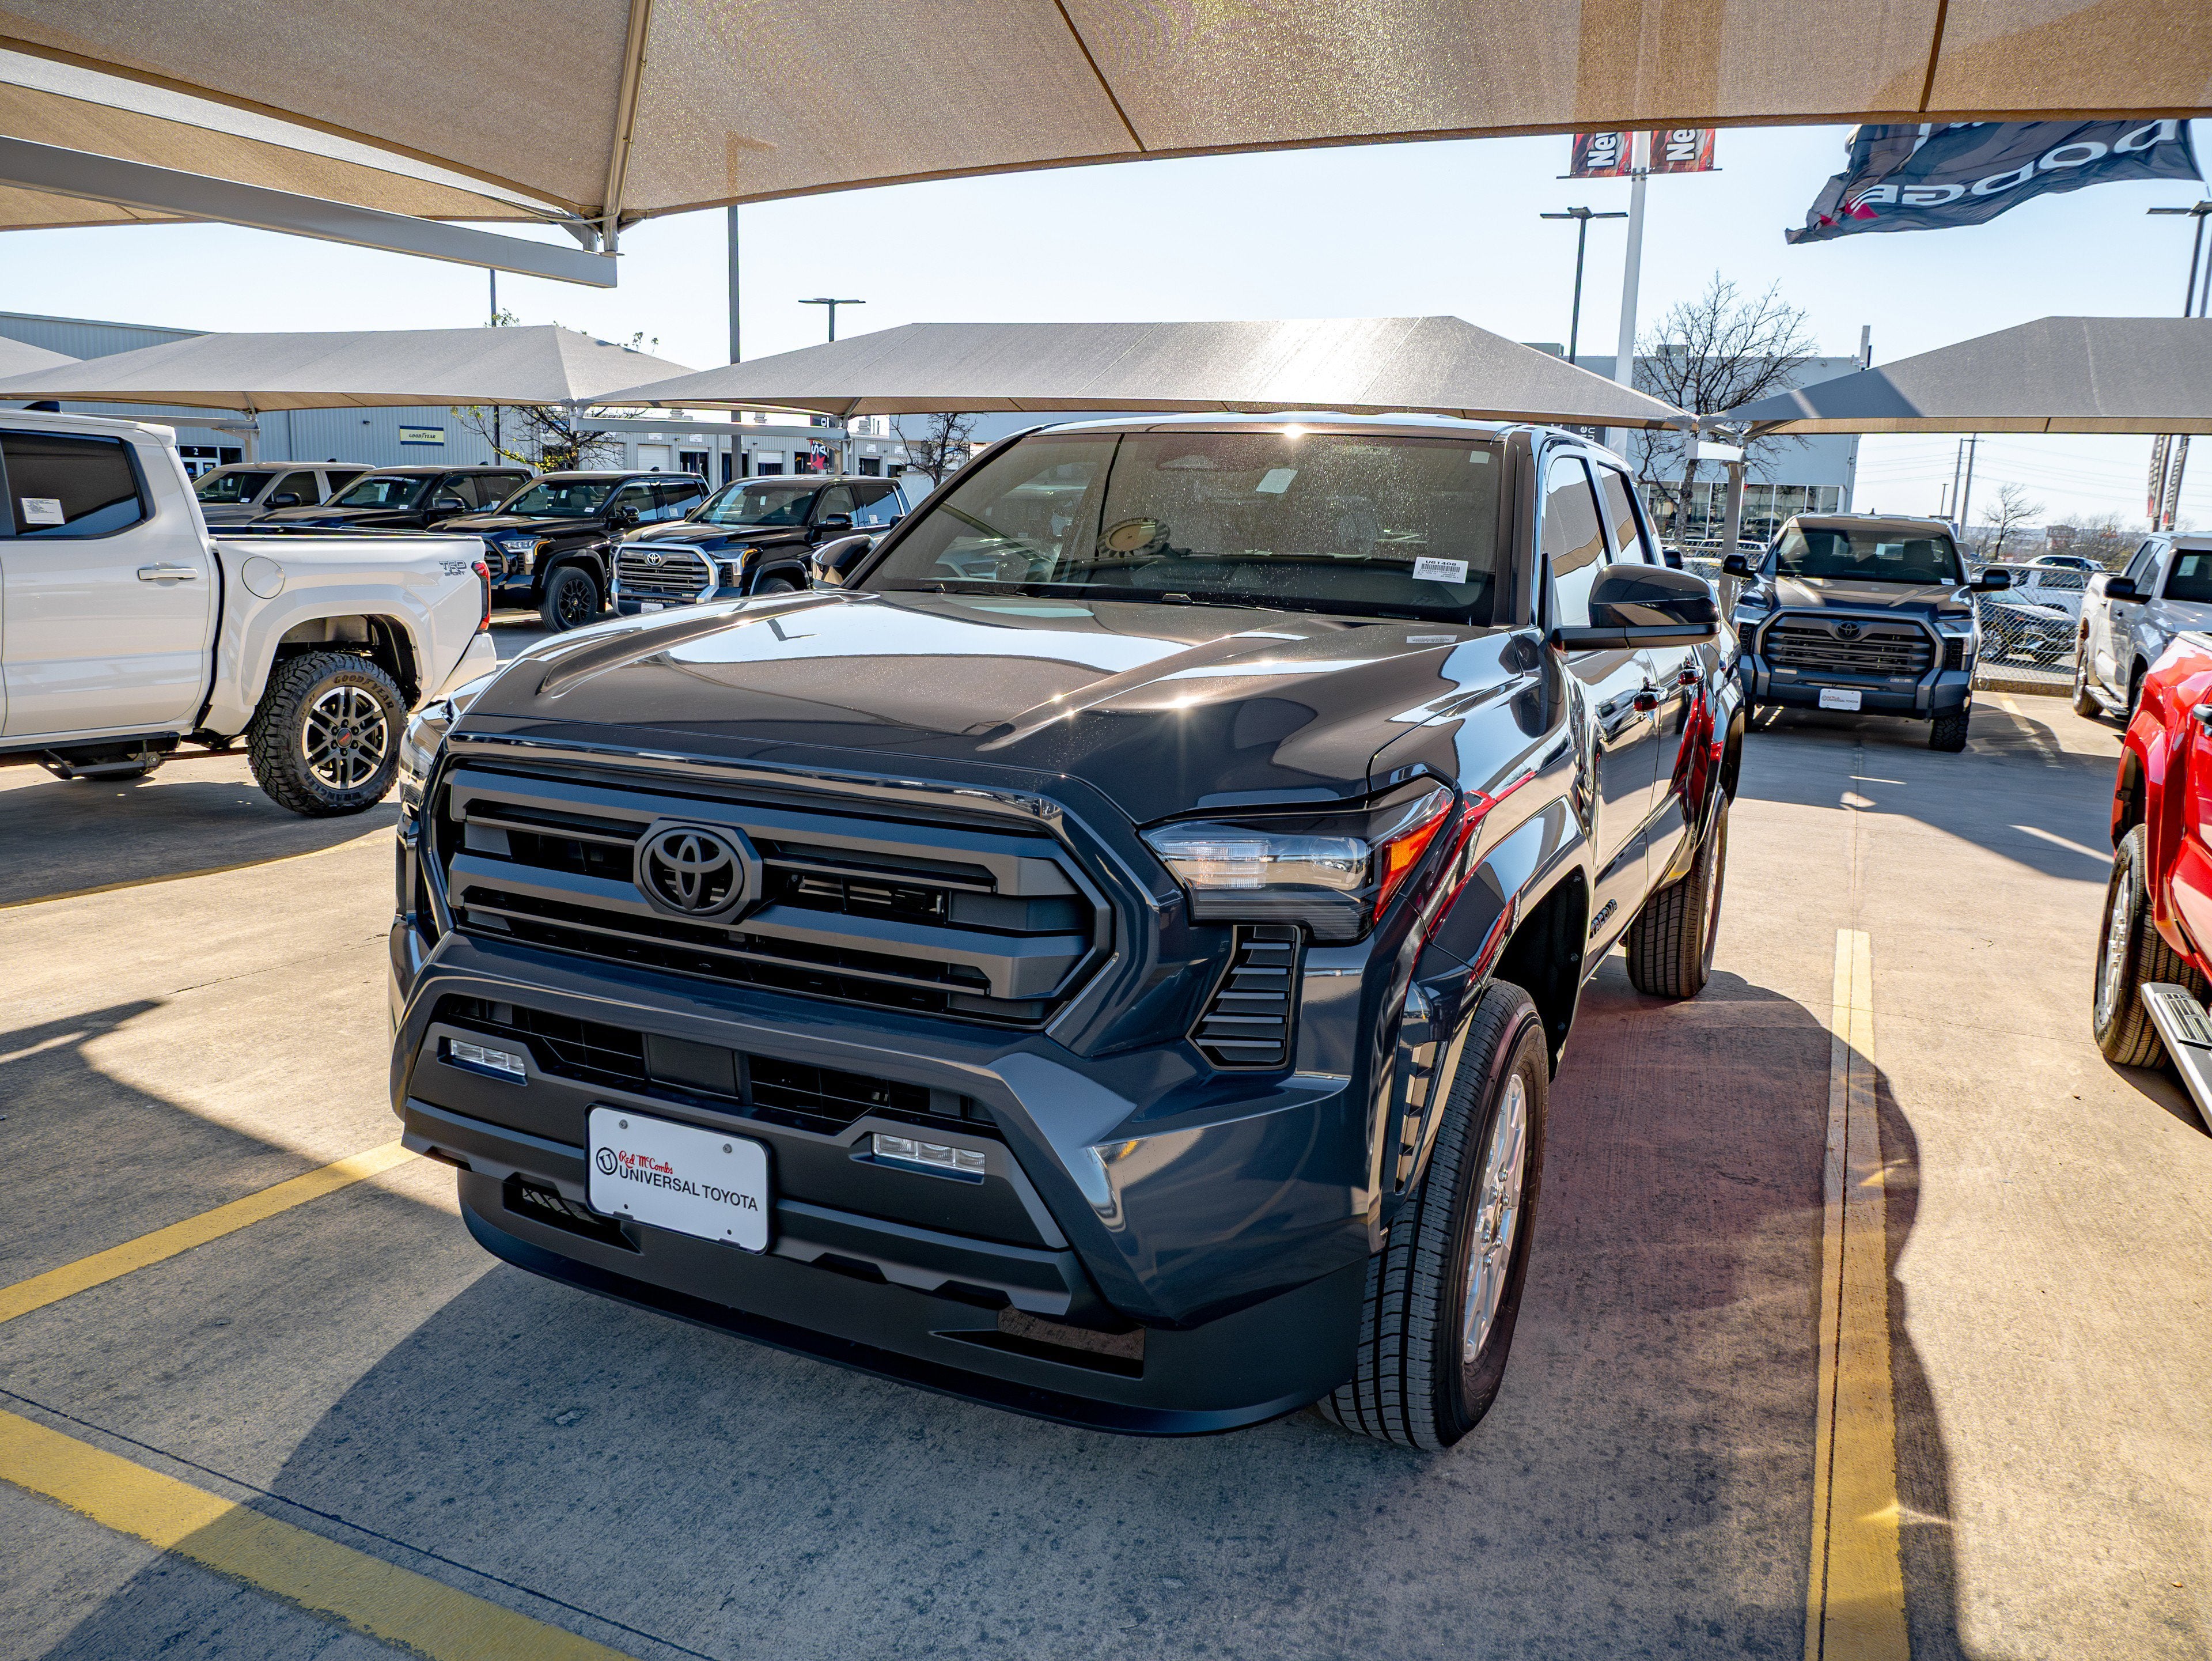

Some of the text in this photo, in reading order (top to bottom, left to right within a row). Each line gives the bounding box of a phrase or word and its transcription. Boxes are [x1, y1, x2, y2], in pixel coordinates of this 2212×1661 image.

[439, 560, 467, 572] TRD
[333, 674, 395, 710] GOODYEAR
[619, 1150, 673, 1175] Red McCombs
[620, 1165, 759, 1212] UNIVERSAL TOYOTA
